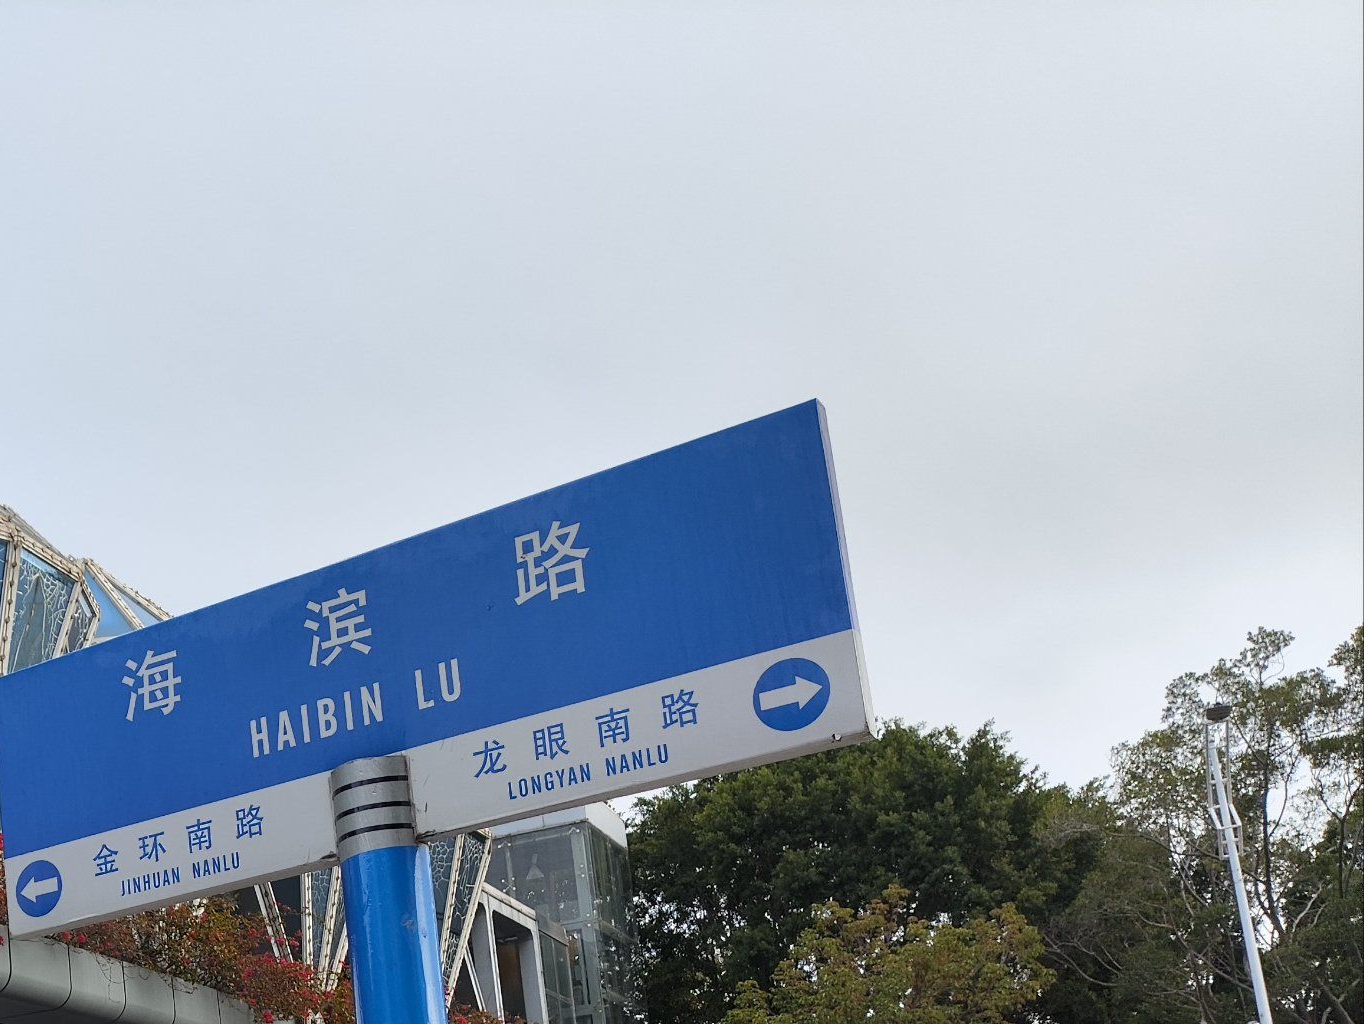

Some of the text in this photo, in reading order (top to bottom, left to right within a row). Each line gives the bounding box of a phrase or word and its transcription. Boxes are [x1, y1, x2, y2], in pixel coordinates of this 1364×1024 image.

[122, 522, 588, 721] 海滨路
[251, 659, 461, 757] HAIBIN LU
[473, 689, 699, 778] 龙眼南路
[508, 744, 669, 800] LONGYAN NANLU
[93, 805, 265, 877] 金环南路
[121, 852, 240, 896] JINHUAN NANLU
